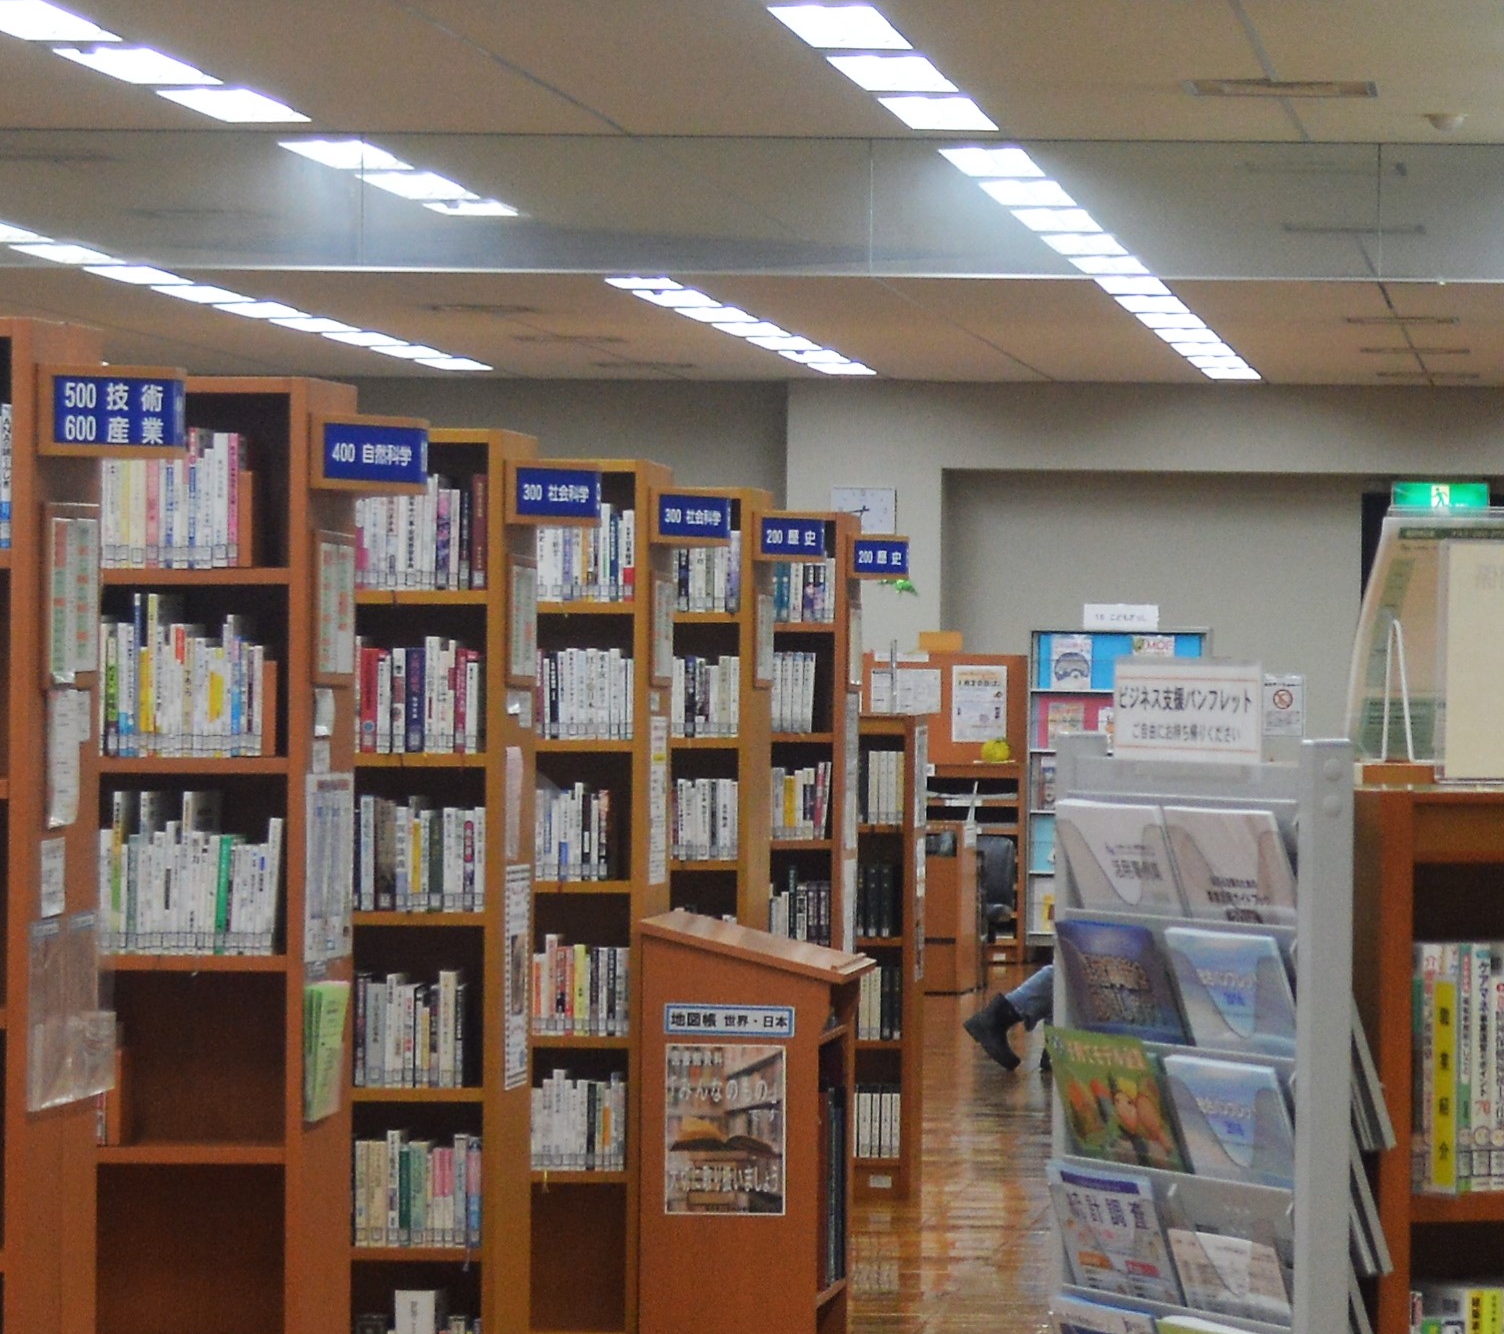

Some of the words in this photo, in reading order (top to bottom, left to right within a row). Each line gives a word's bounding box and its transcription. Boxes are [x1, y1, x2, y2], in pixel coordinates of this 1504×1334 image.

[65, 382, 97, 409] 500
[106, 382, 164, 412] 技術
[64, 415, 97, 442] 600
[106, 416, 164, 445] 産業
[331, 443, 357, 463] 400
[361, 444, 412, 466] 自然科学
[523, 484, 544, 501] 300
[548, 484, 590, 504] 社会科学
[663, 508, 683, 524] 300
[686, 508, 722, 527] 社会科学
[766, 529, 785, 545] 200
[858, 550, 875, 565] 200
[1118, 686, 1253, 714] ビジネス支援パンフレット
[670, 1012, 718, 1028] 地図帳
[723, 1013, 789, 1030] 世界・日本
